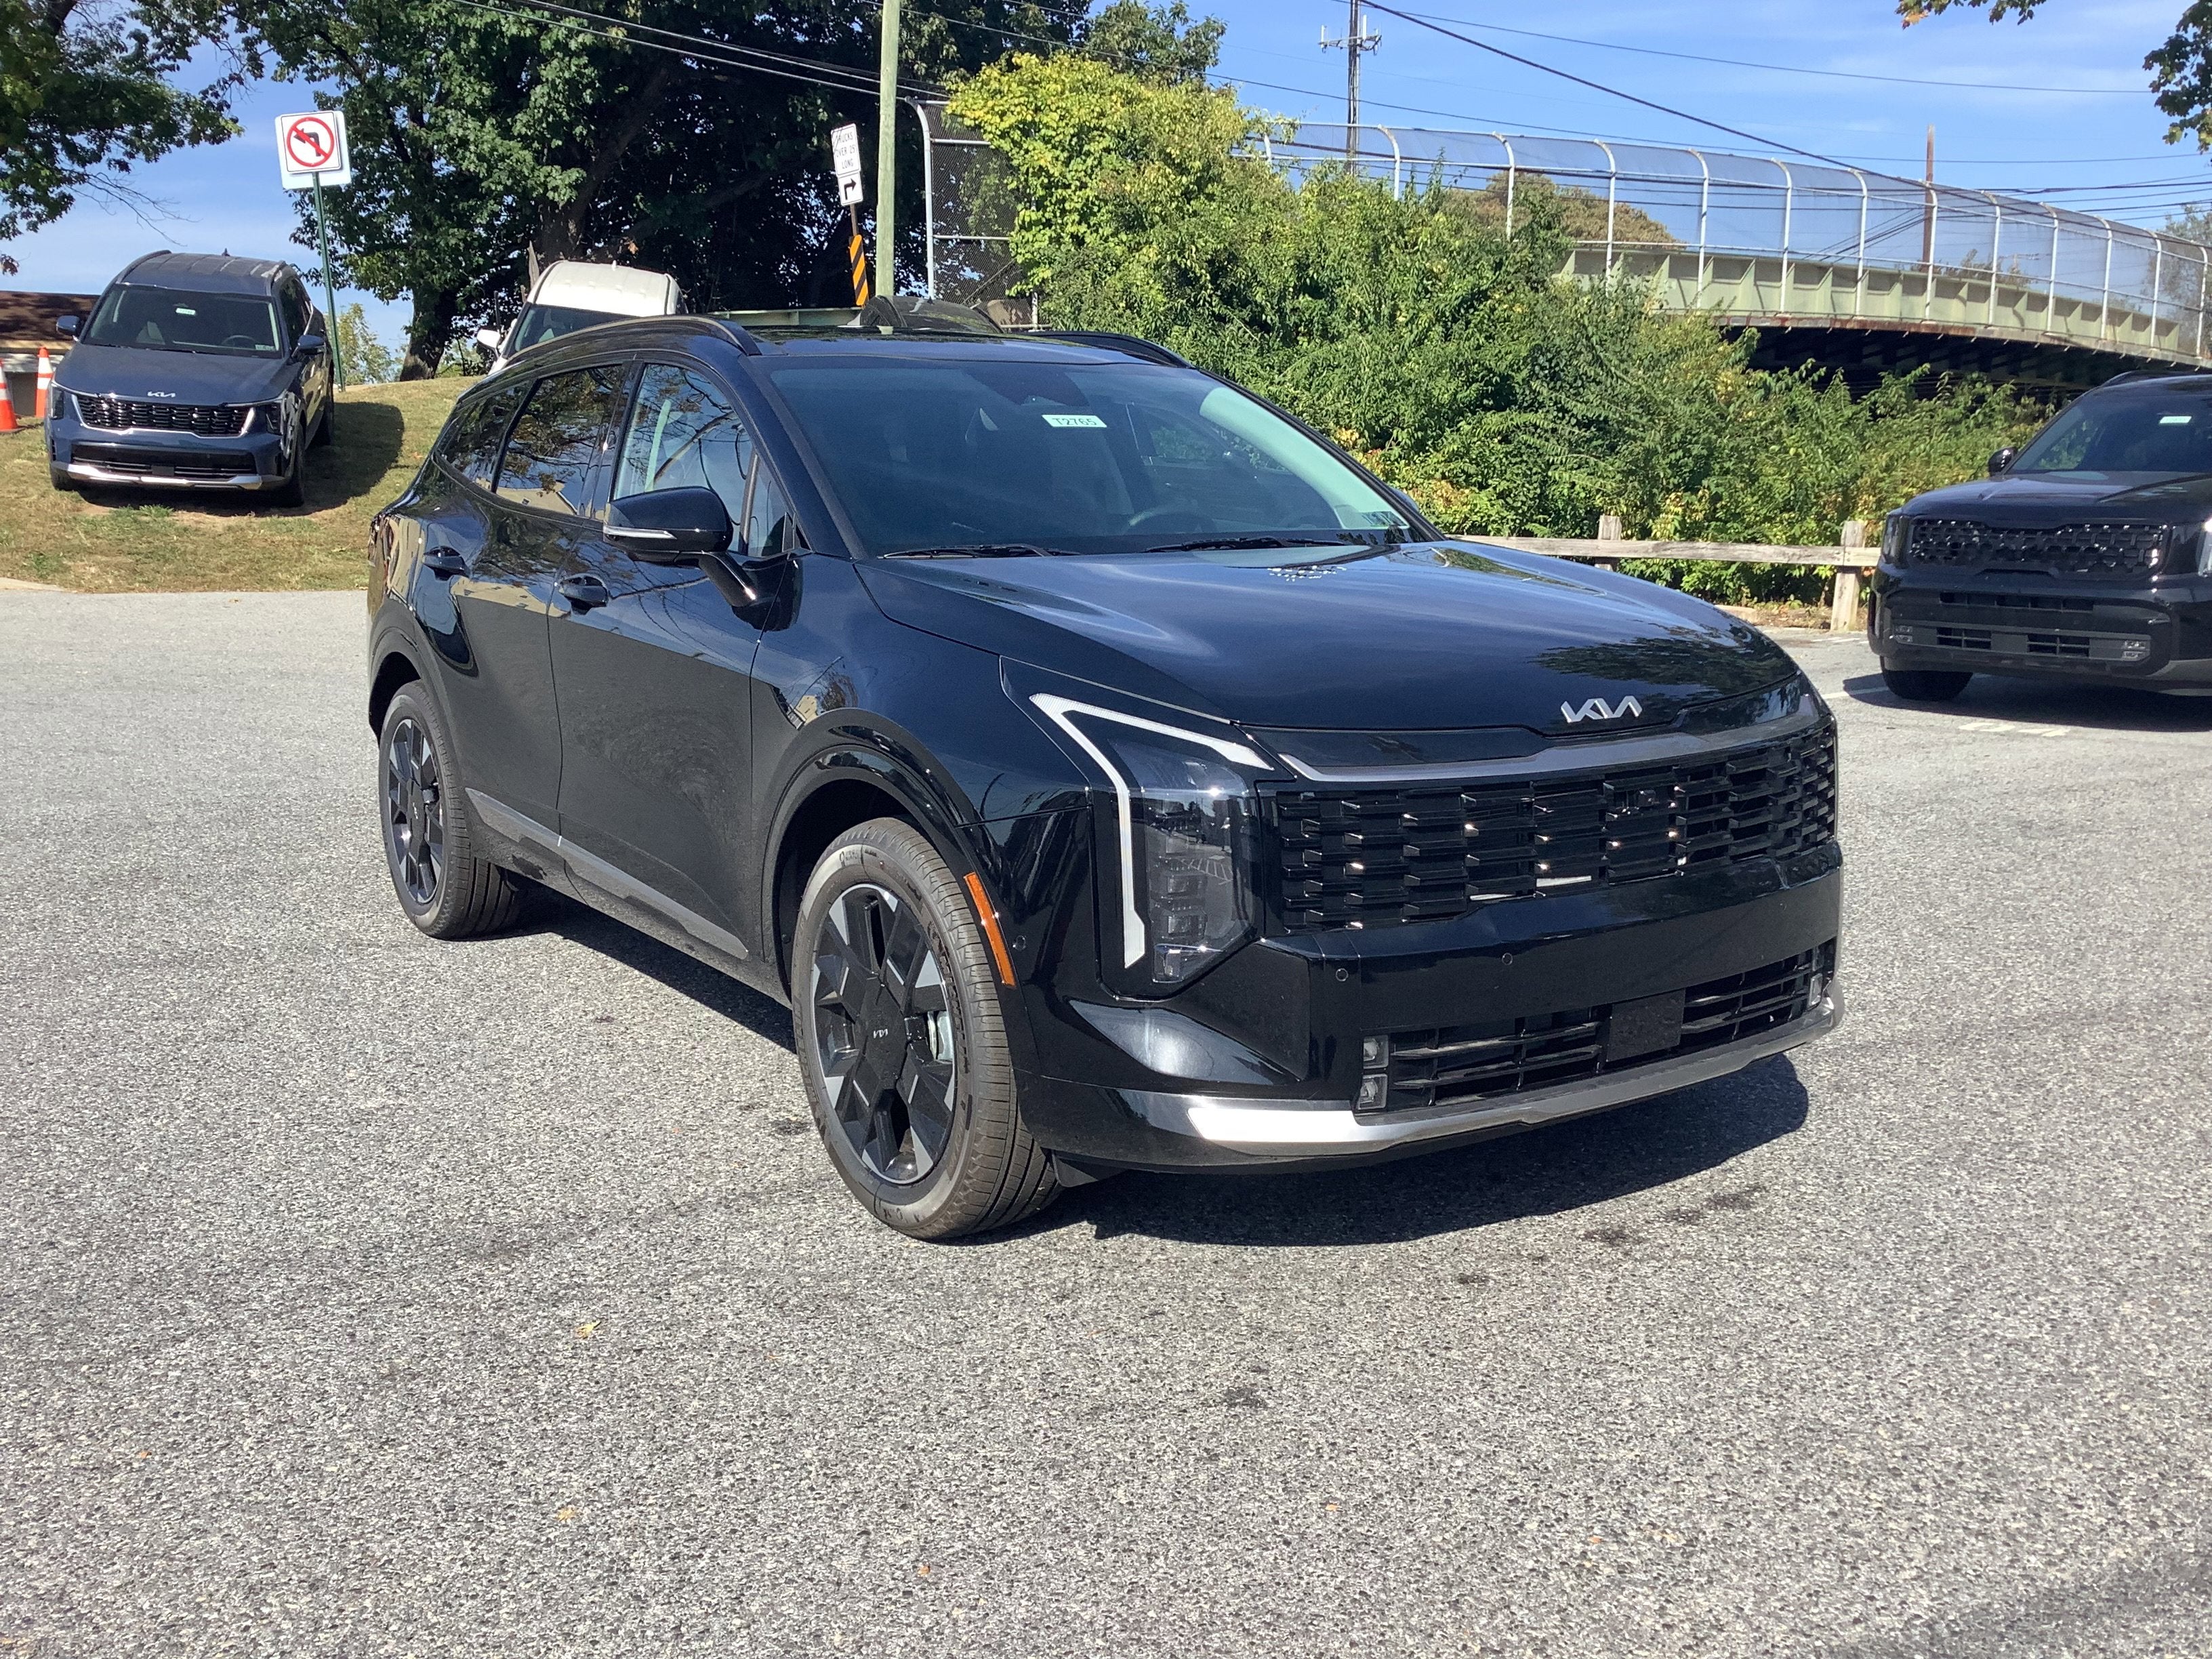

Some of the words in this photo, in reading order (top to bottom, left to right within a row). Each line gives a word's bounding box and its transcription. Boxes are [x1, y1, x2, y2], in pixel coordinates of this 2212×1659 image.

[842, 159, 853, 169] LONG
[1052, 417, 1097, 426] T2765
[1561, 695, 1642, 723] KIA
